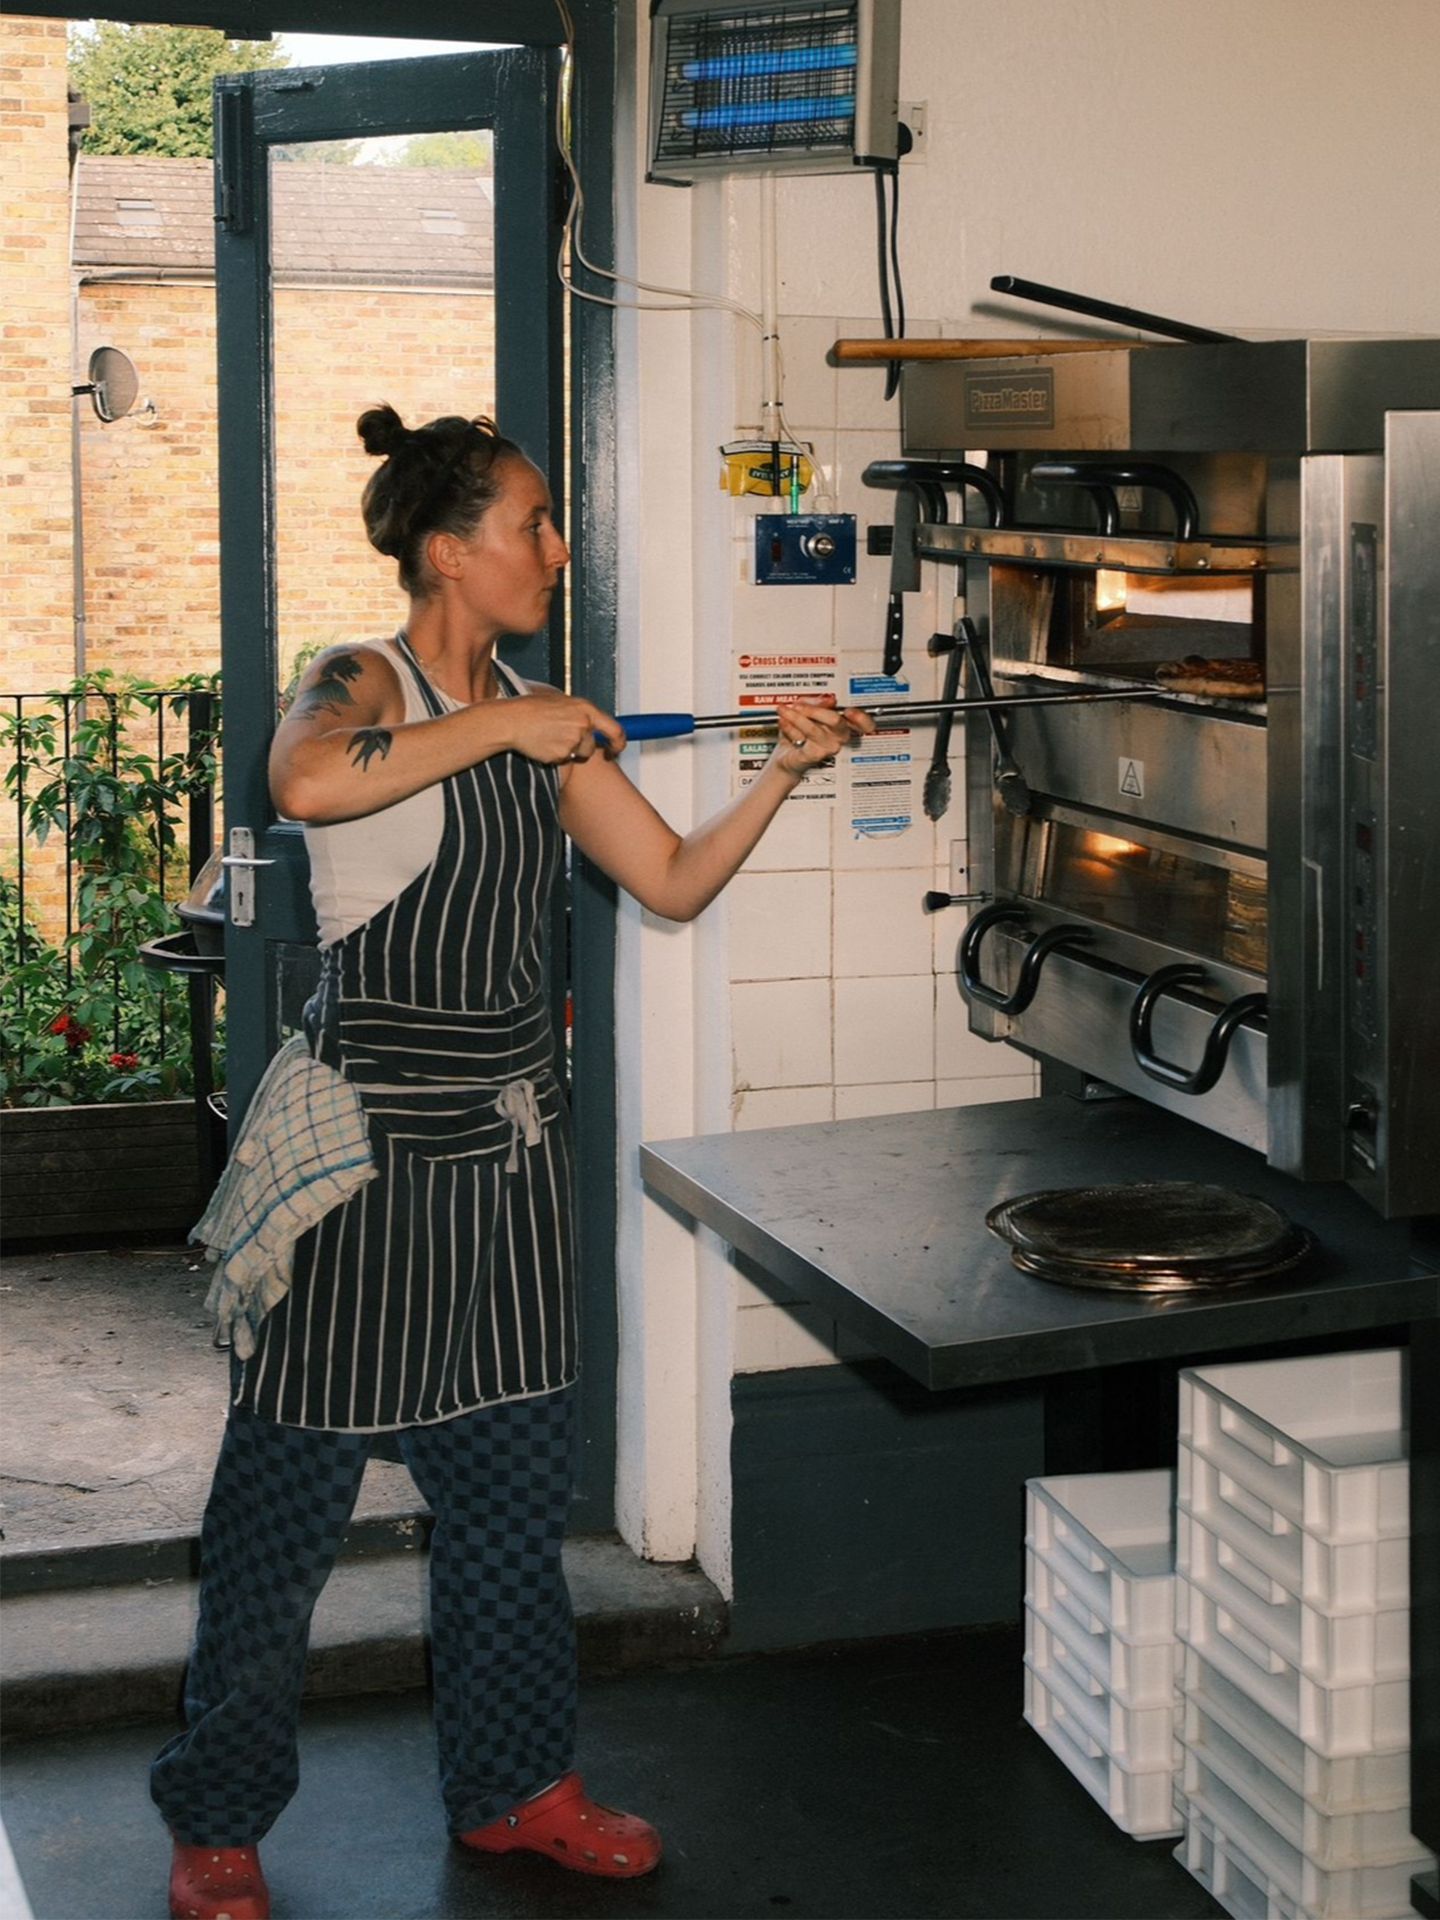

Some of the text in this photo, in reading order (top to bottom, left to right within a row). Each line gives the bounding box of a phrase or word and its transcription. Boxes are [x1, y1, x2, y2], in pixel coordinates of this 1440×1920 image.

[971, 388, 1047, 412] PizzaMaster
[753, 656, 777, 666] CROSS
[778, 655, 836, 665] CONTAMINATION
[754, 695, 774, 704] RAW
